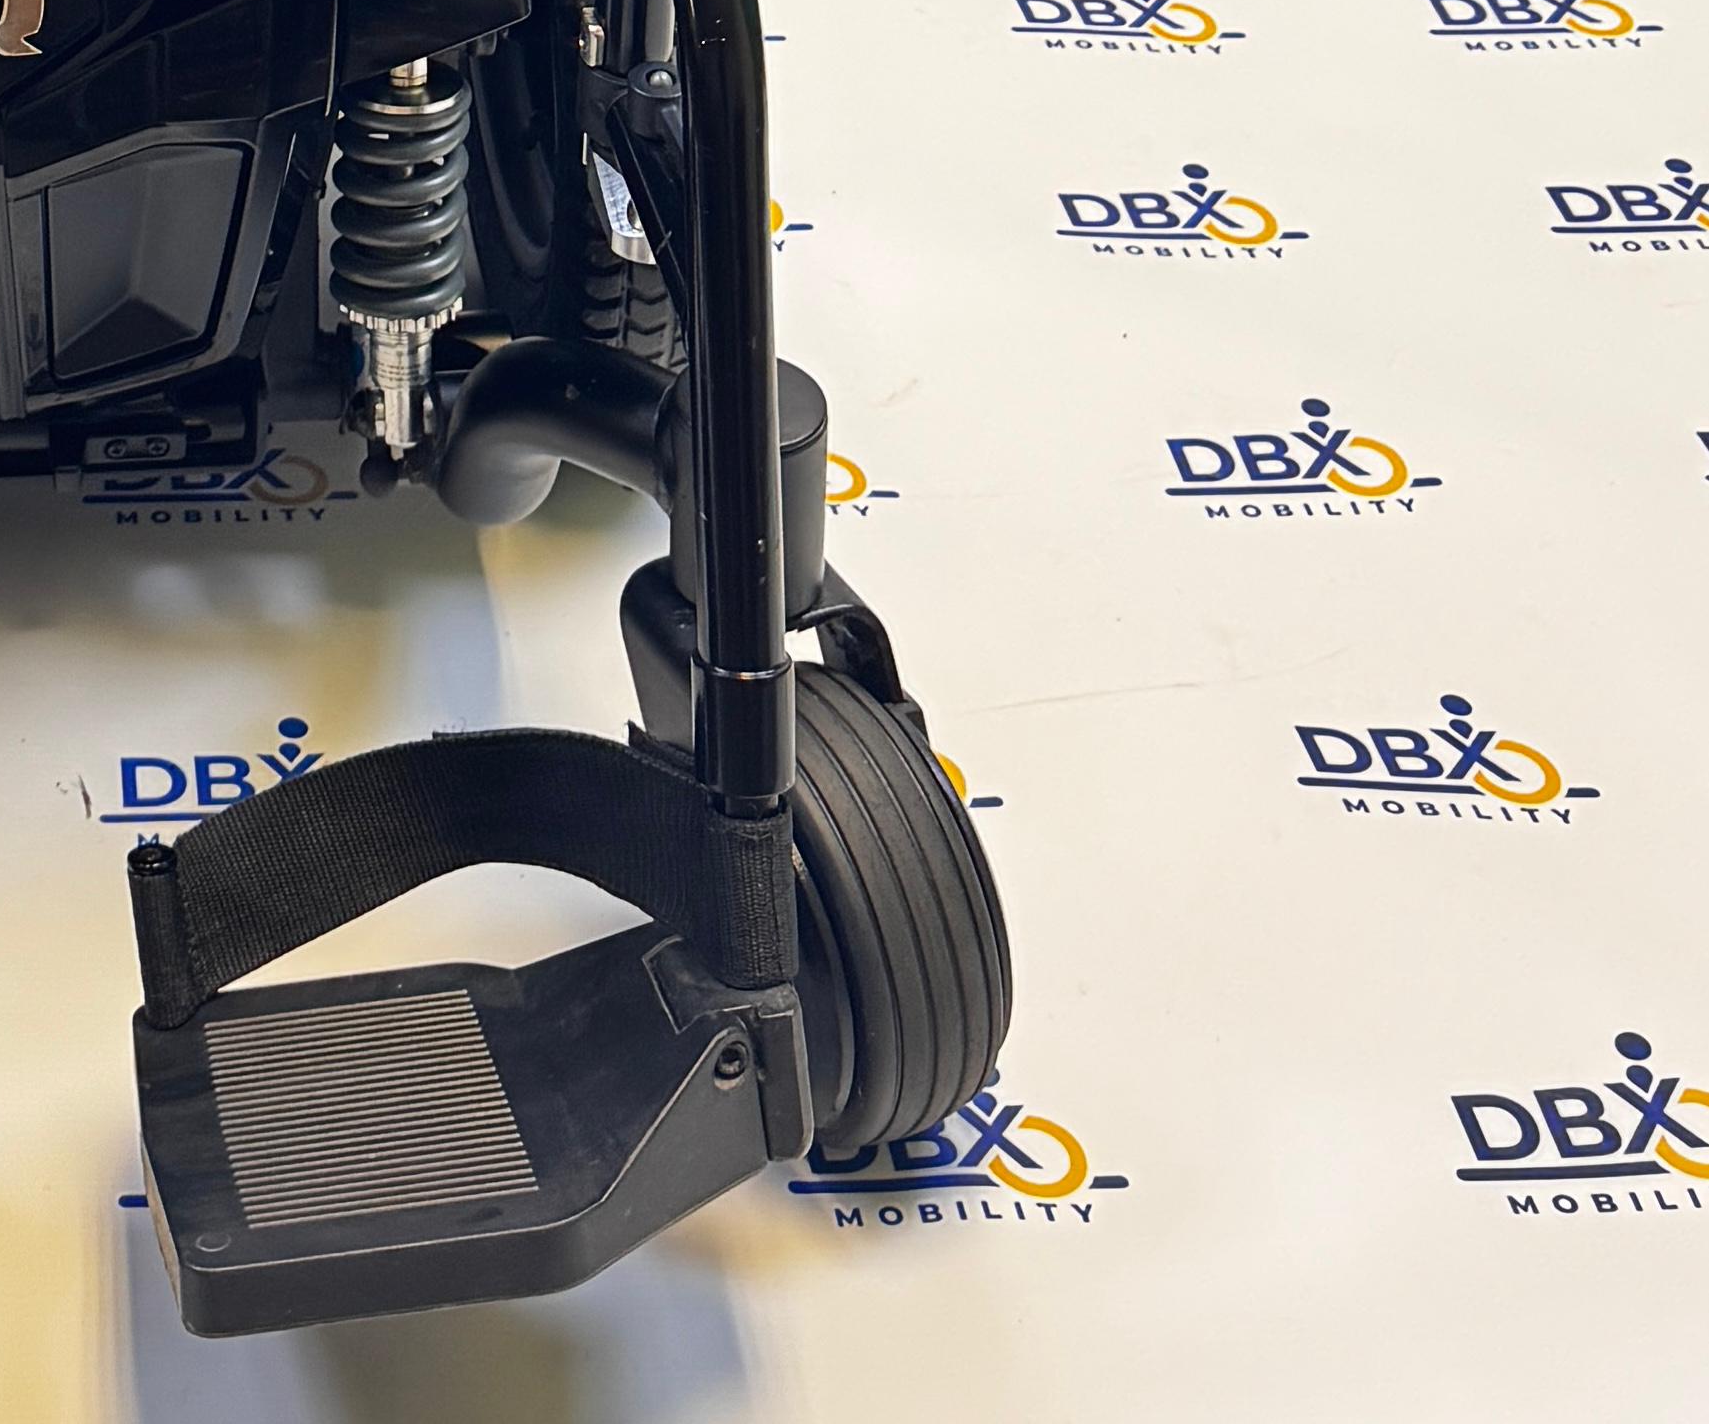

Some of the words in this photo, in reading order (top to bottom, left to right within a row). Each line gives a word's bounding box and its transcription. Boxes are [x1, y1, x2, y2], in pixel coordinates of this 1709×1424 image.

[1045, 39, 1221, 55] MOBILITY
[1464, 37, 1641, 51] MOBILITY
[1058, 189, 1244, 229] DBX
[1092, 243, 1283, 259] MOBILITY
[1589, 238, 1709, 253] MOBIL
[1165, 429, 1371, 483] DBX
[115, 506, 327, 526] MOBILITY
[1204, 497, 1414, 519] MOBILITY
[1294, 725, 1522, 783] DBX
[1341, 798, 1571, 825] MOBILITY
[1506, 1187, 1702, 1215] MOBILI
[833, 1200, 1094, 1228] MOBILITY
